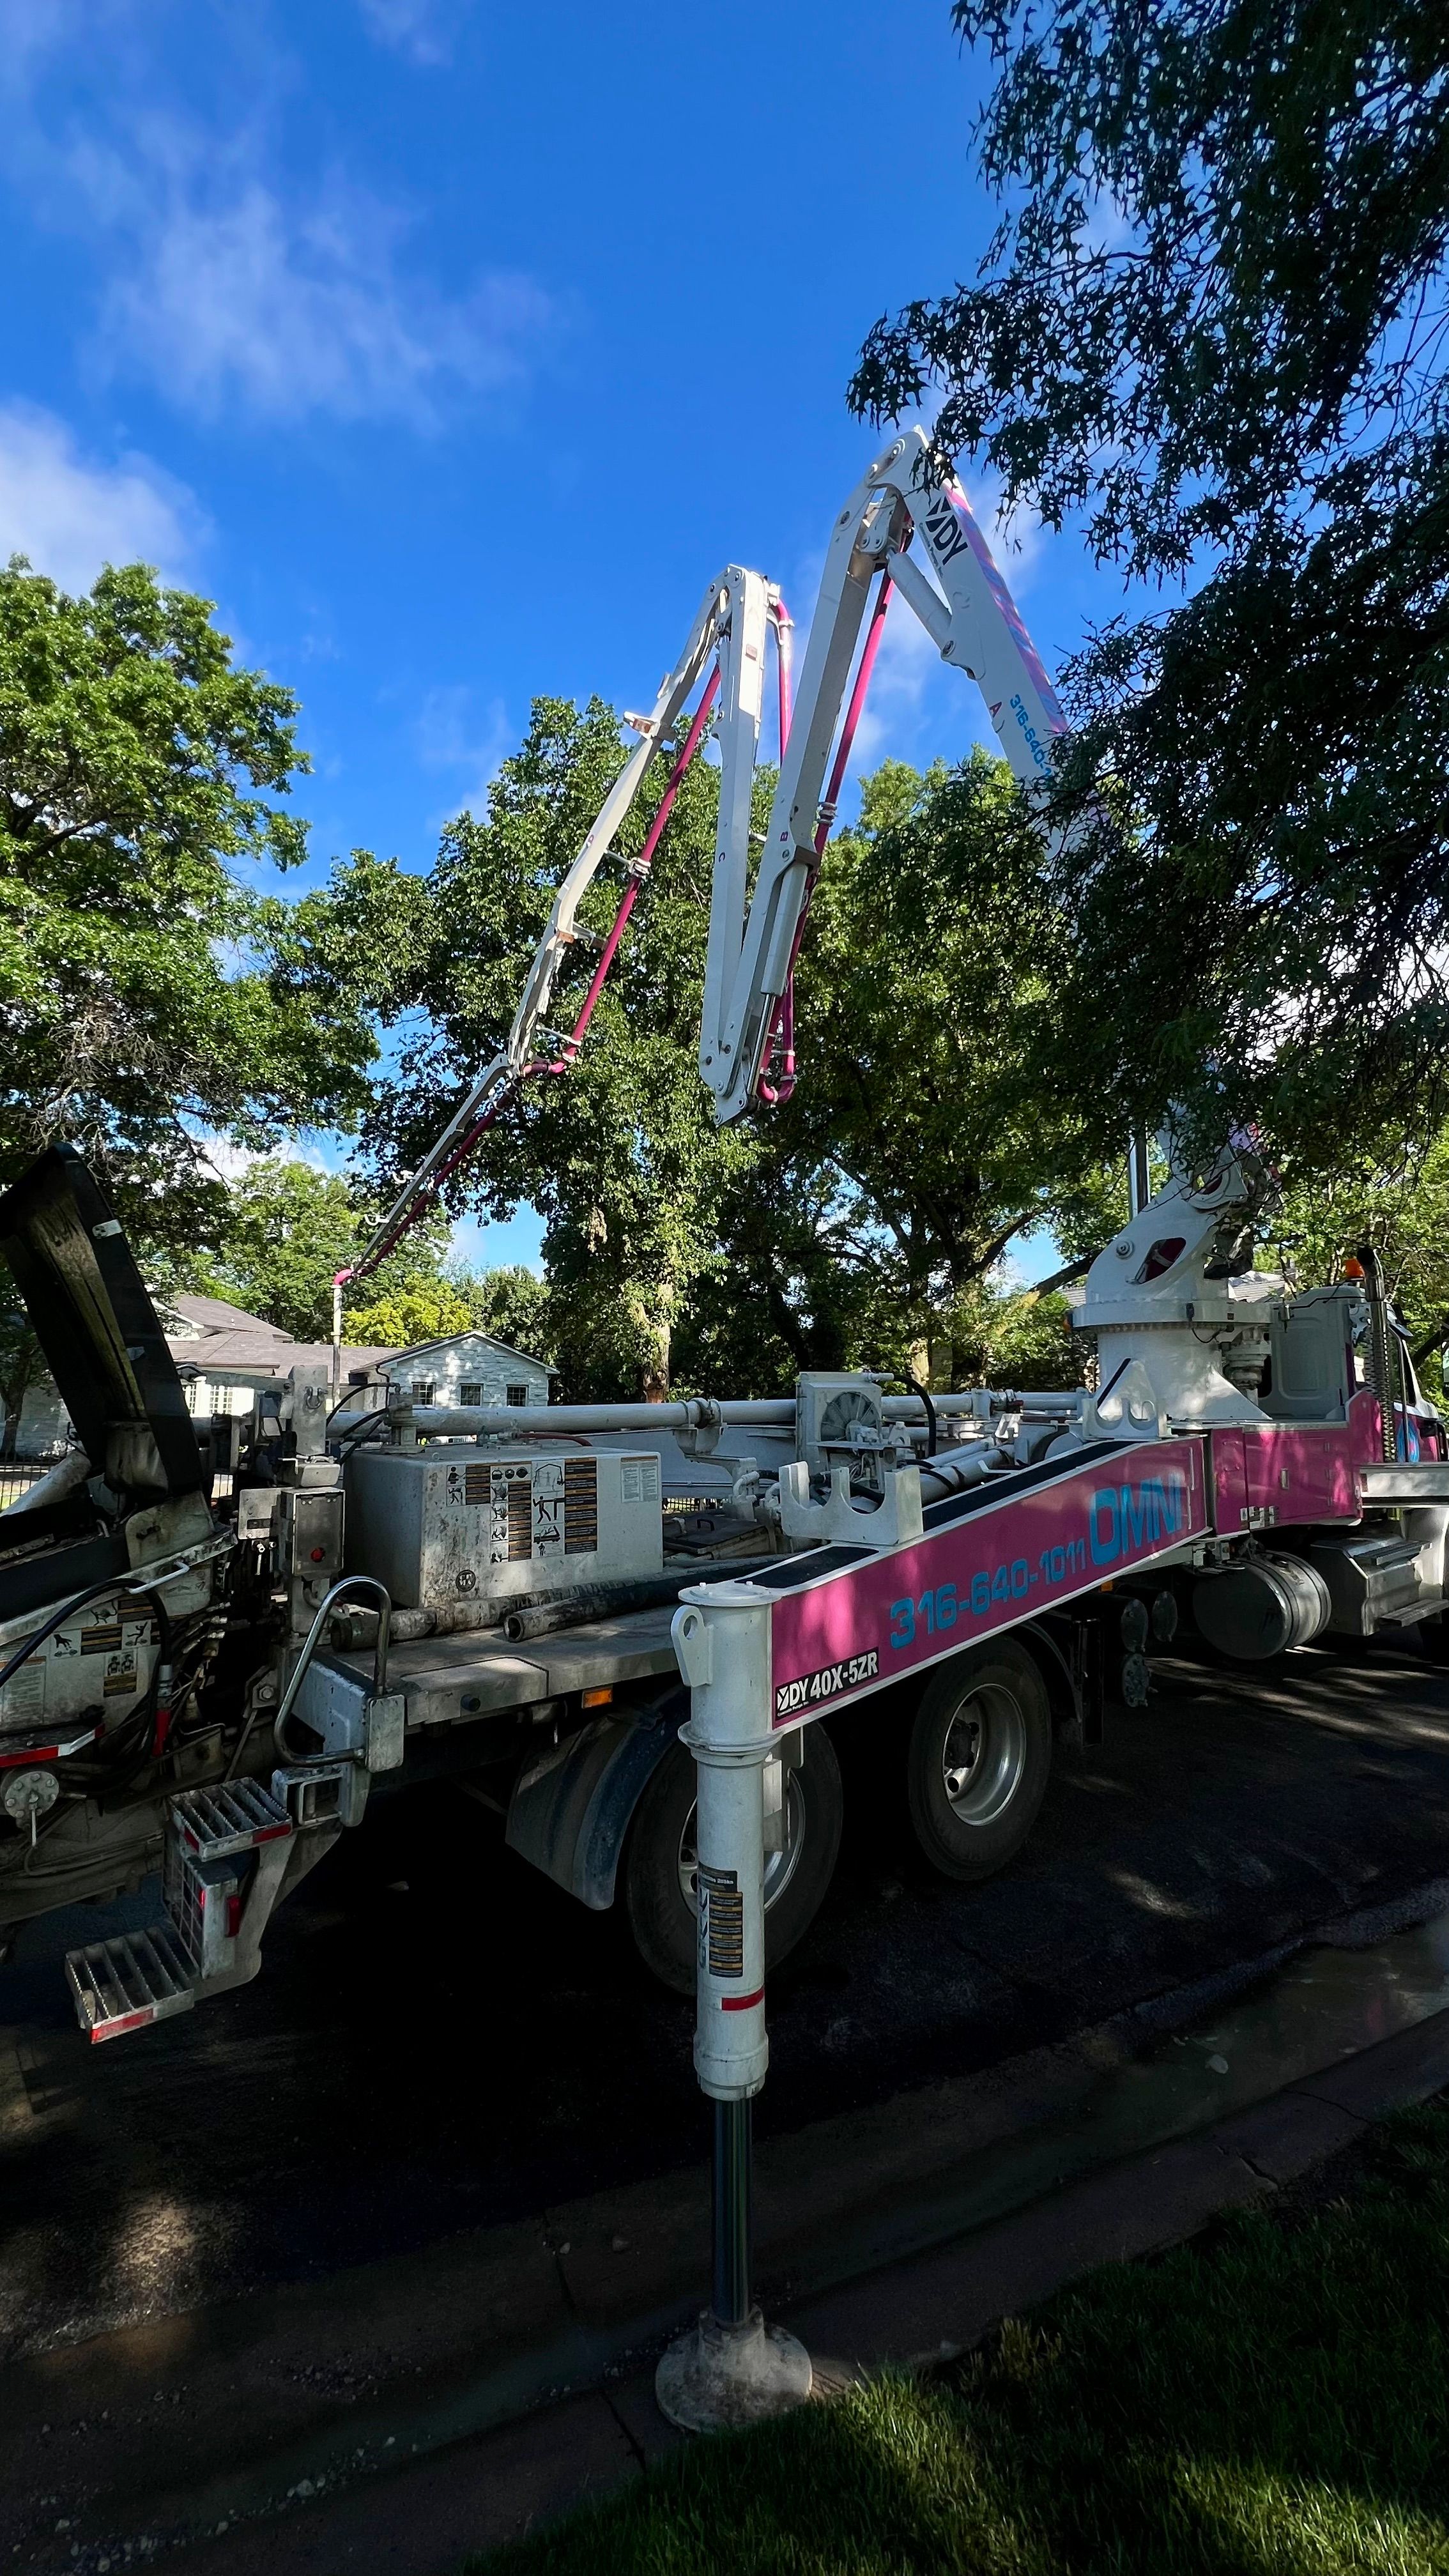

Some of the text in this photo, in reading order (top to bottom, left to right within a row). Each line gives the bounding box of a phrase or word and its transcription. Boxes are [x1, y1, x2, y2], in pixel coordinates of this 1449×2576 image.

[1089, 1473, 1182, 1565] OMNI
[890, 1538, 1086, 1650] 316-640-1011
[810, 1651, 878, 1699] 40X-5ZR
